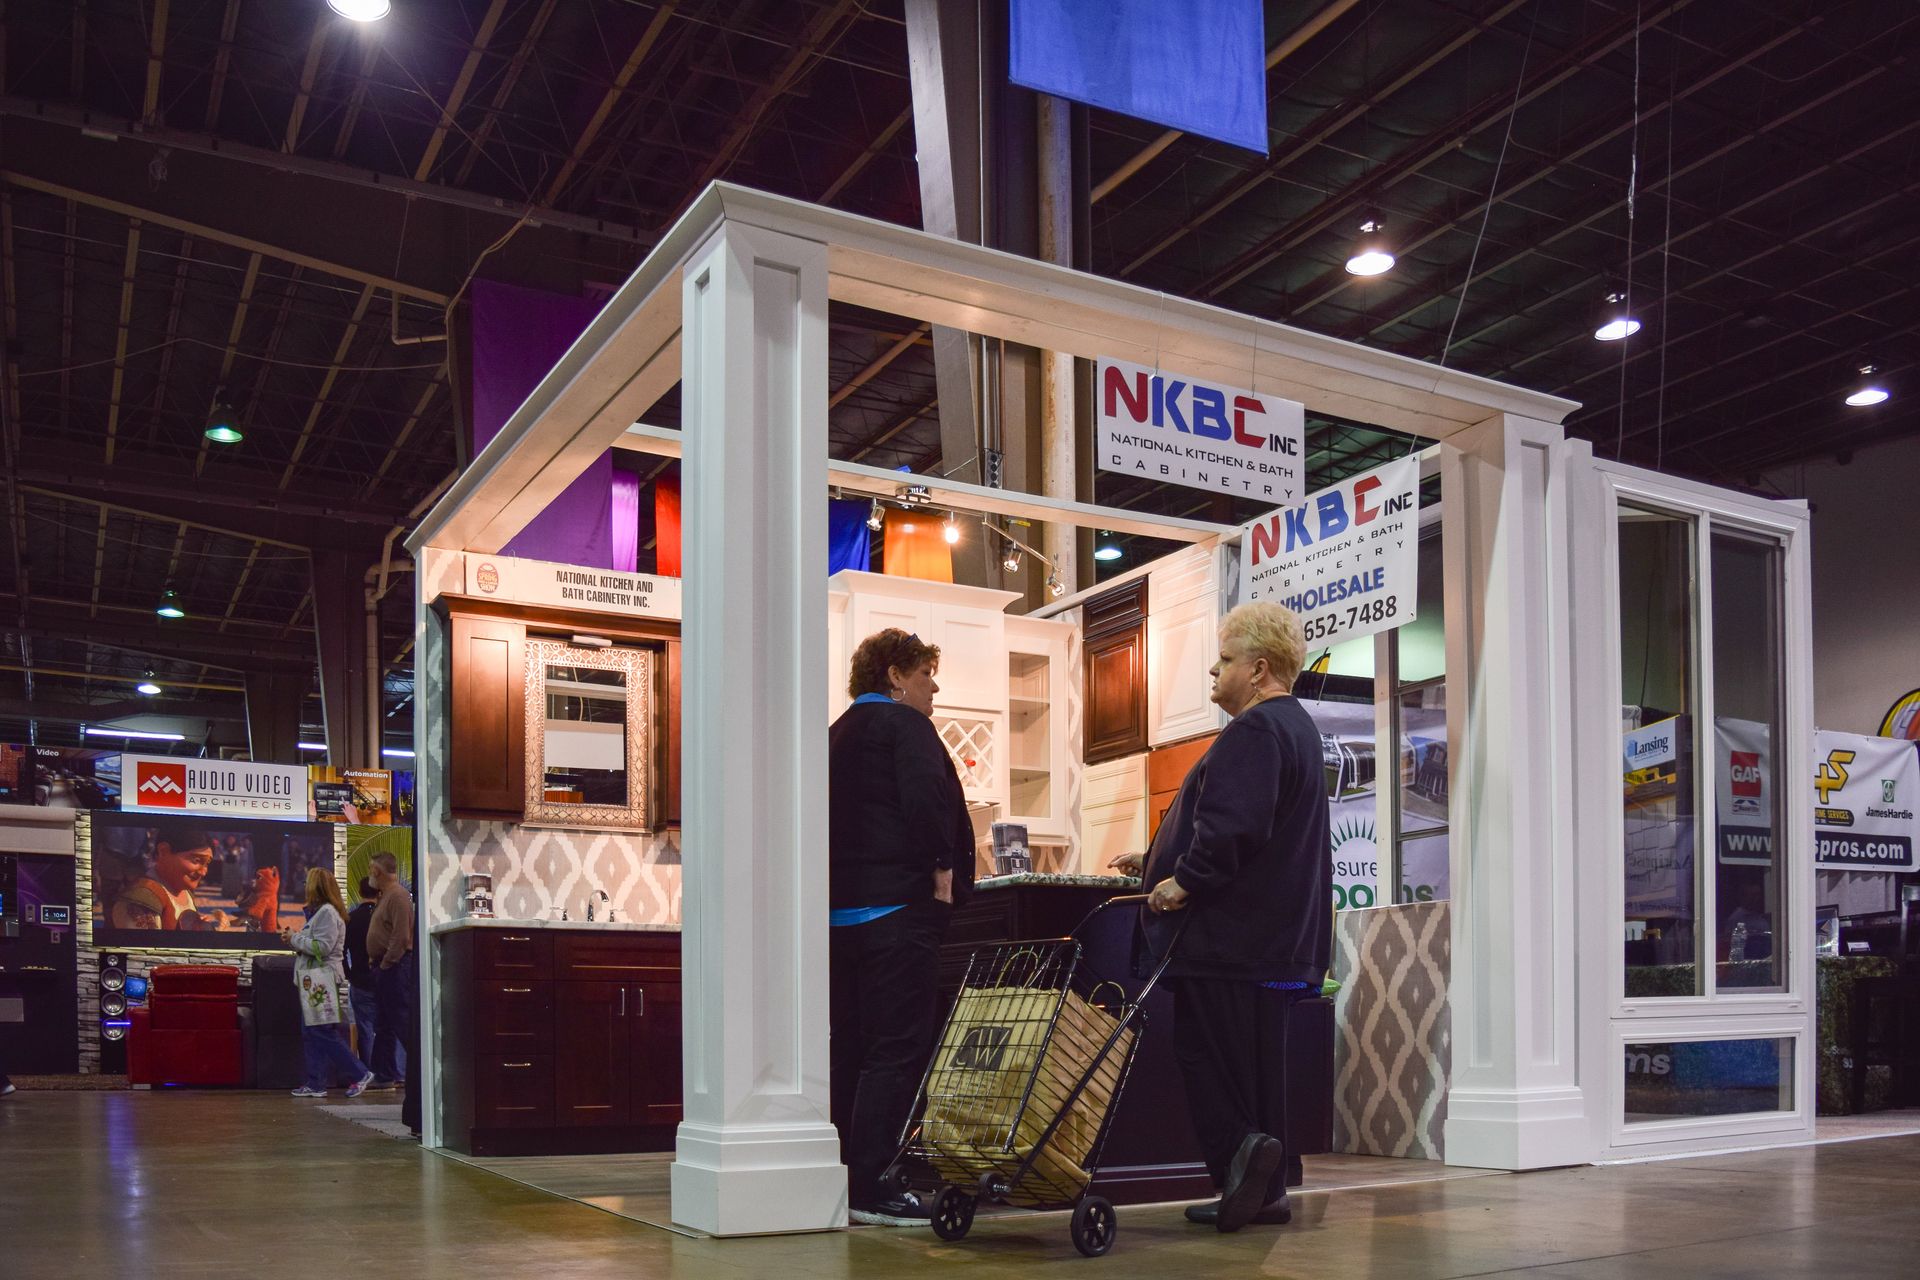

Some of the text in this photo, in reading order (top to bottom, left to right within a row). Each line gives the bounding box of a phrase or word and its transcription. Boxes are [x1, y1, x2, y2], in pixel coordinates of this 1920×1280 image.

[1104, 365, 1298, 457] NKBC INC
[1111, 432, 1293, 479] NATIONAL KITCHEN & BATH
[1112, 455, 1293, 499] CABINETRY
[1251, 475, 1413, 566] NKBC INC
[1251, 522, 1403, 583] NATIONAL KITCHEN & BATH
[556, 570, 653, 593] NATIONAL KITCHEN AND
[1251, 540, 1404, 600] CABINETRY
[562, 587, 650, 609] BATH CABINETRY INC.
[36, 748, 59, 757] Video
[1634, 736, 1669, 754] Lansing
[189, 769, 291, 795] AUDIO VIDEO
[343, 769, 389, 779] Automation
[1731, 764, 1760, 784] GAF
[188, 797, 292, 811] ARCHITECHS
[1865, 806, 1913, 820] JamesHardie
